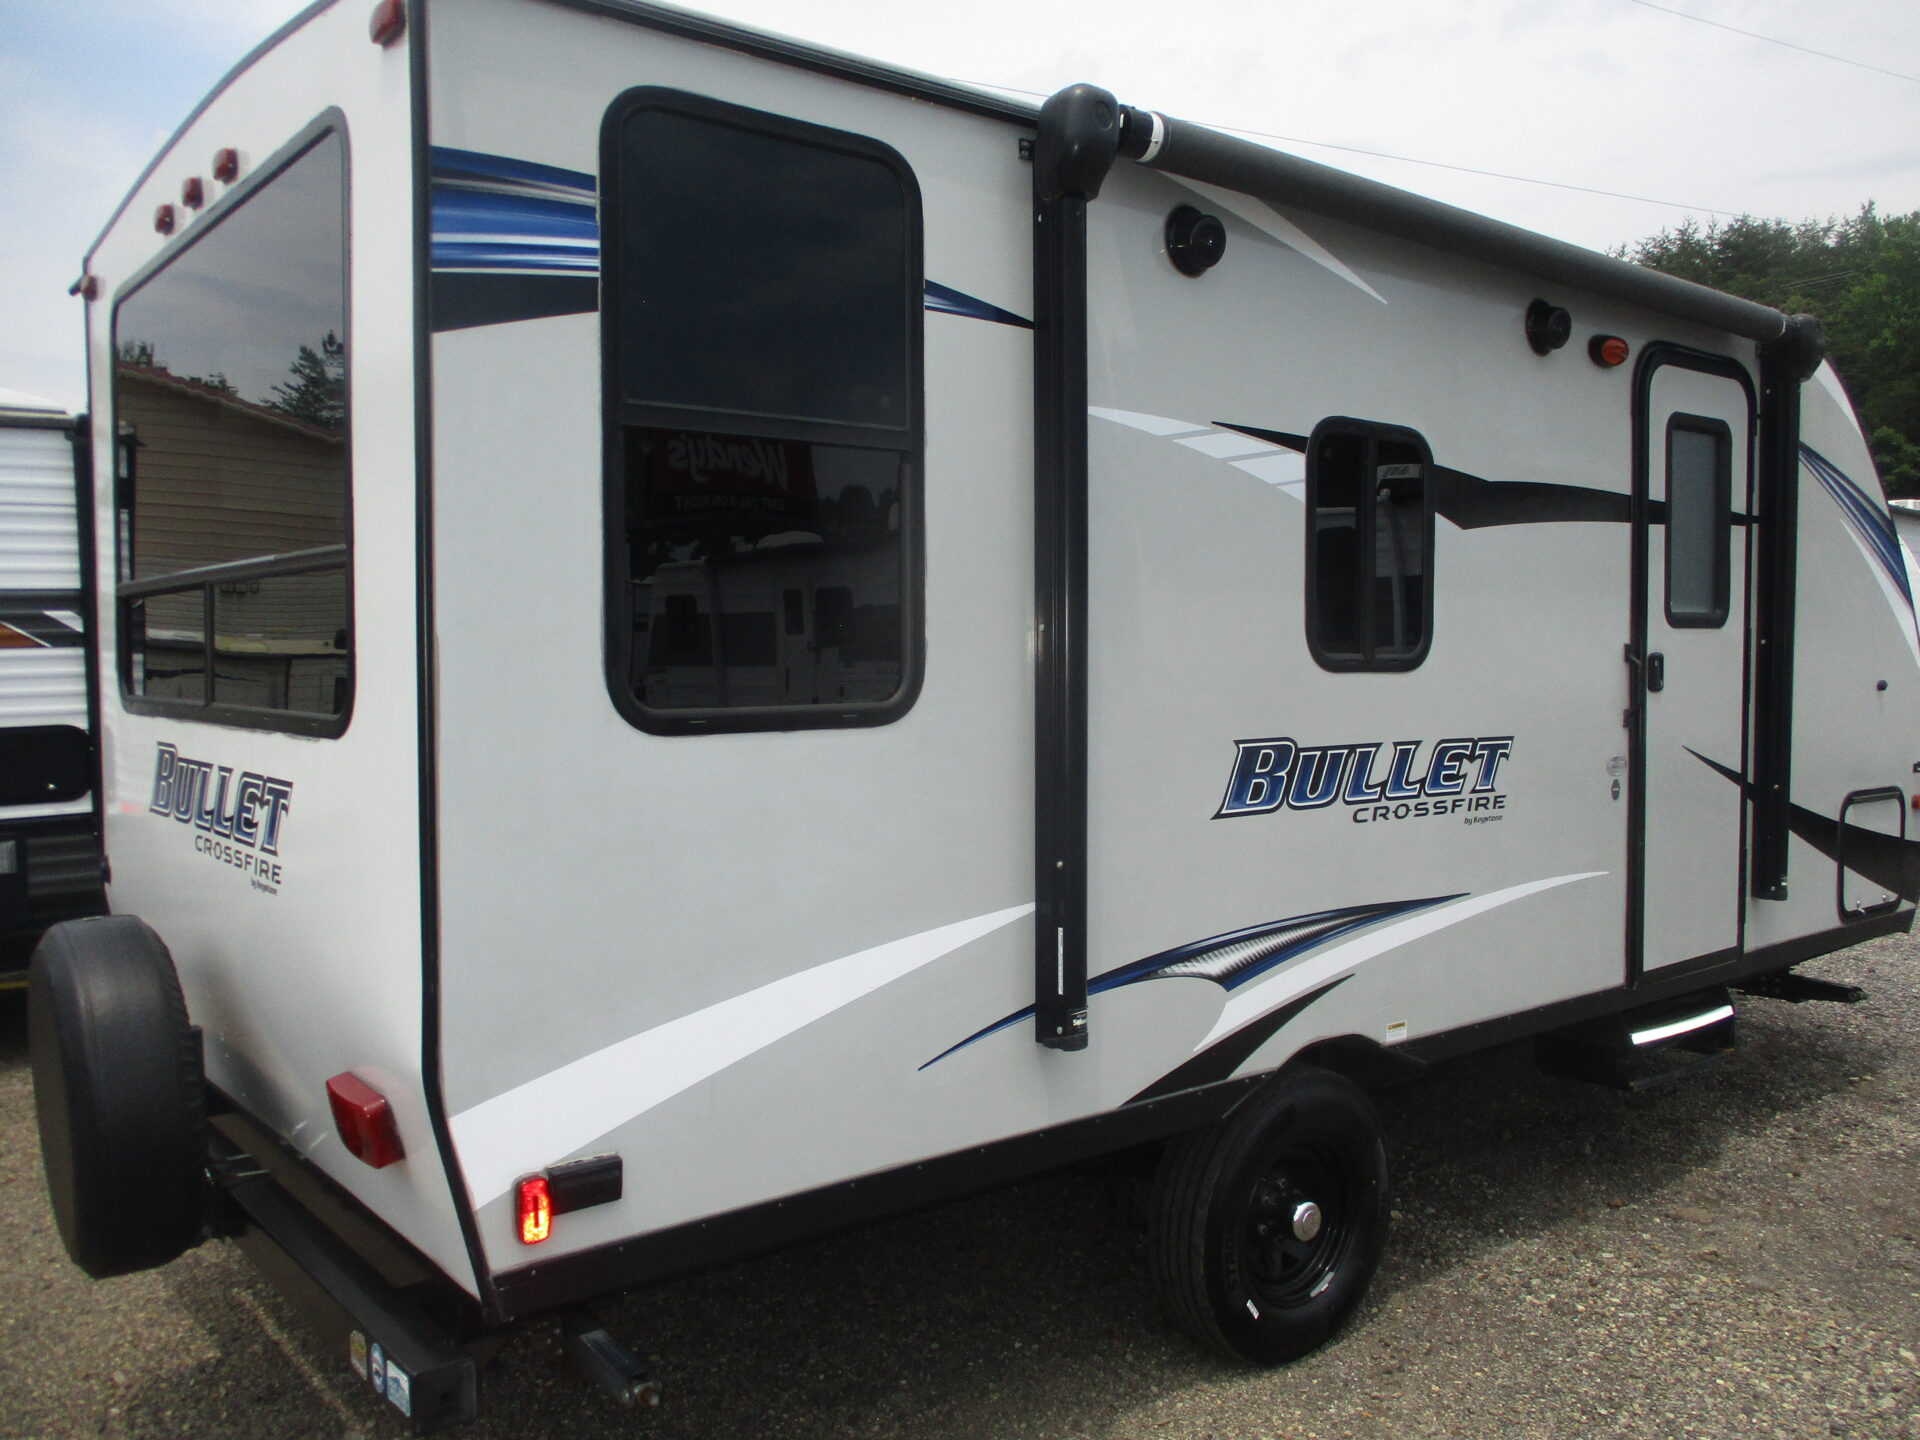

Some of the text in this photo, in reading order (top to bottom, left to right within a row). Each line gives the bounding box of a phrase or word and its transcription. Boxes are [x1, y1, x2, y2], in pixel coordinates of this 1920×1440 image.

[149, 741, 293, 857] BULLET
[1210, 736, 1514, 820] BULLET
[1352, 795, 1507, 824] CROSSFIRE
[1464, 816, 1473, 826] by
[195, 835, 282, 885] CROSSFIRE
